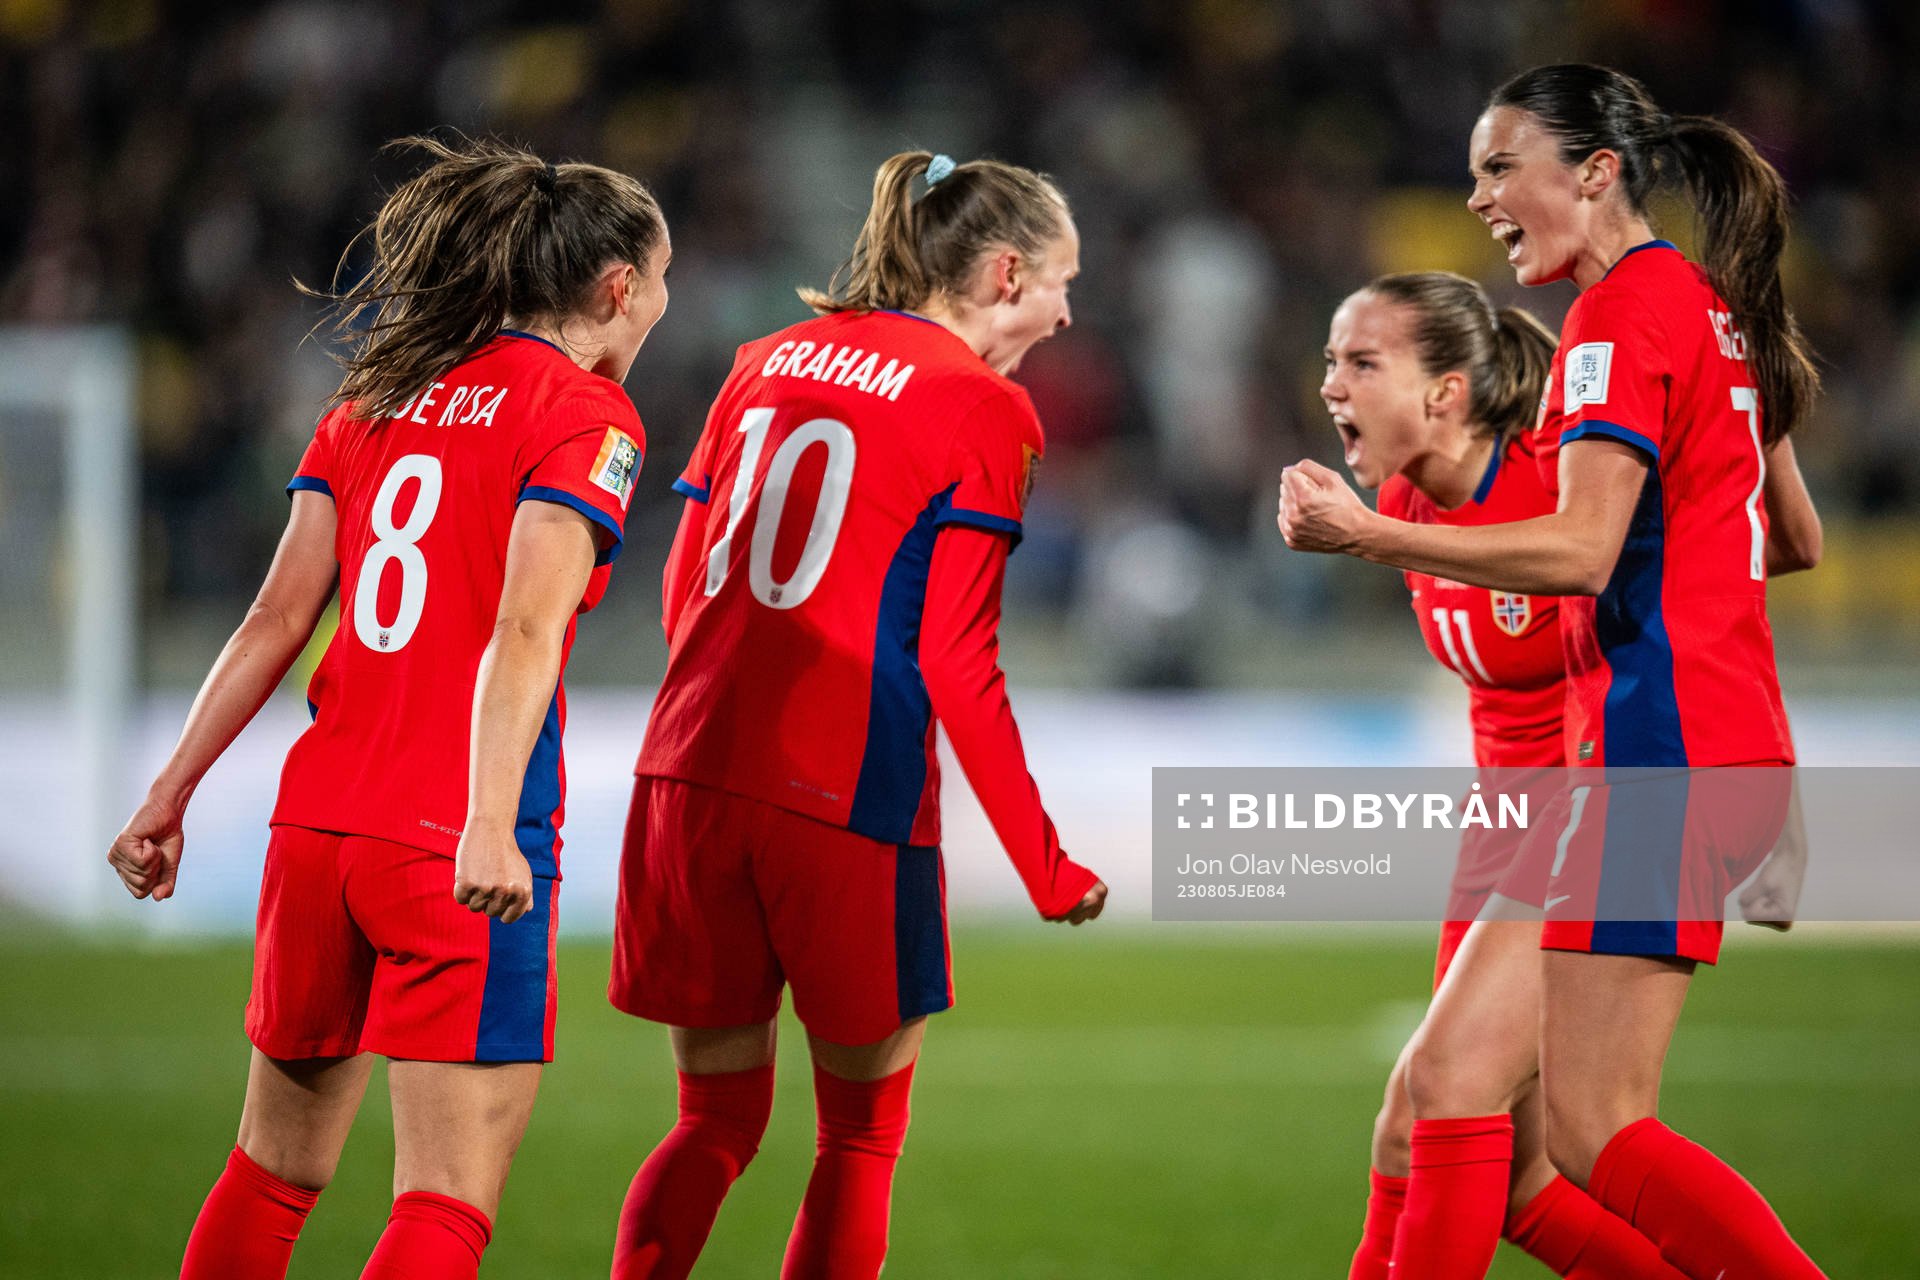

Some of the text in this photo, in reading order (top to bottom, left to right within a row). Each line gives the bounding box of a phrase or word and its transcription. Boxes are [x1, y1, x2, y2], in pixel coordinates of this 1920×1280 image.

[437, 384, 509, 428] RISA
[761, 340, 916, 402] GRAHAM
[703, 406, 856, 609] 10
[1730, 386, 1766, 581] 7
[353, 453, 443, 653] 8
[1431, 607, 1494, 684] 11
